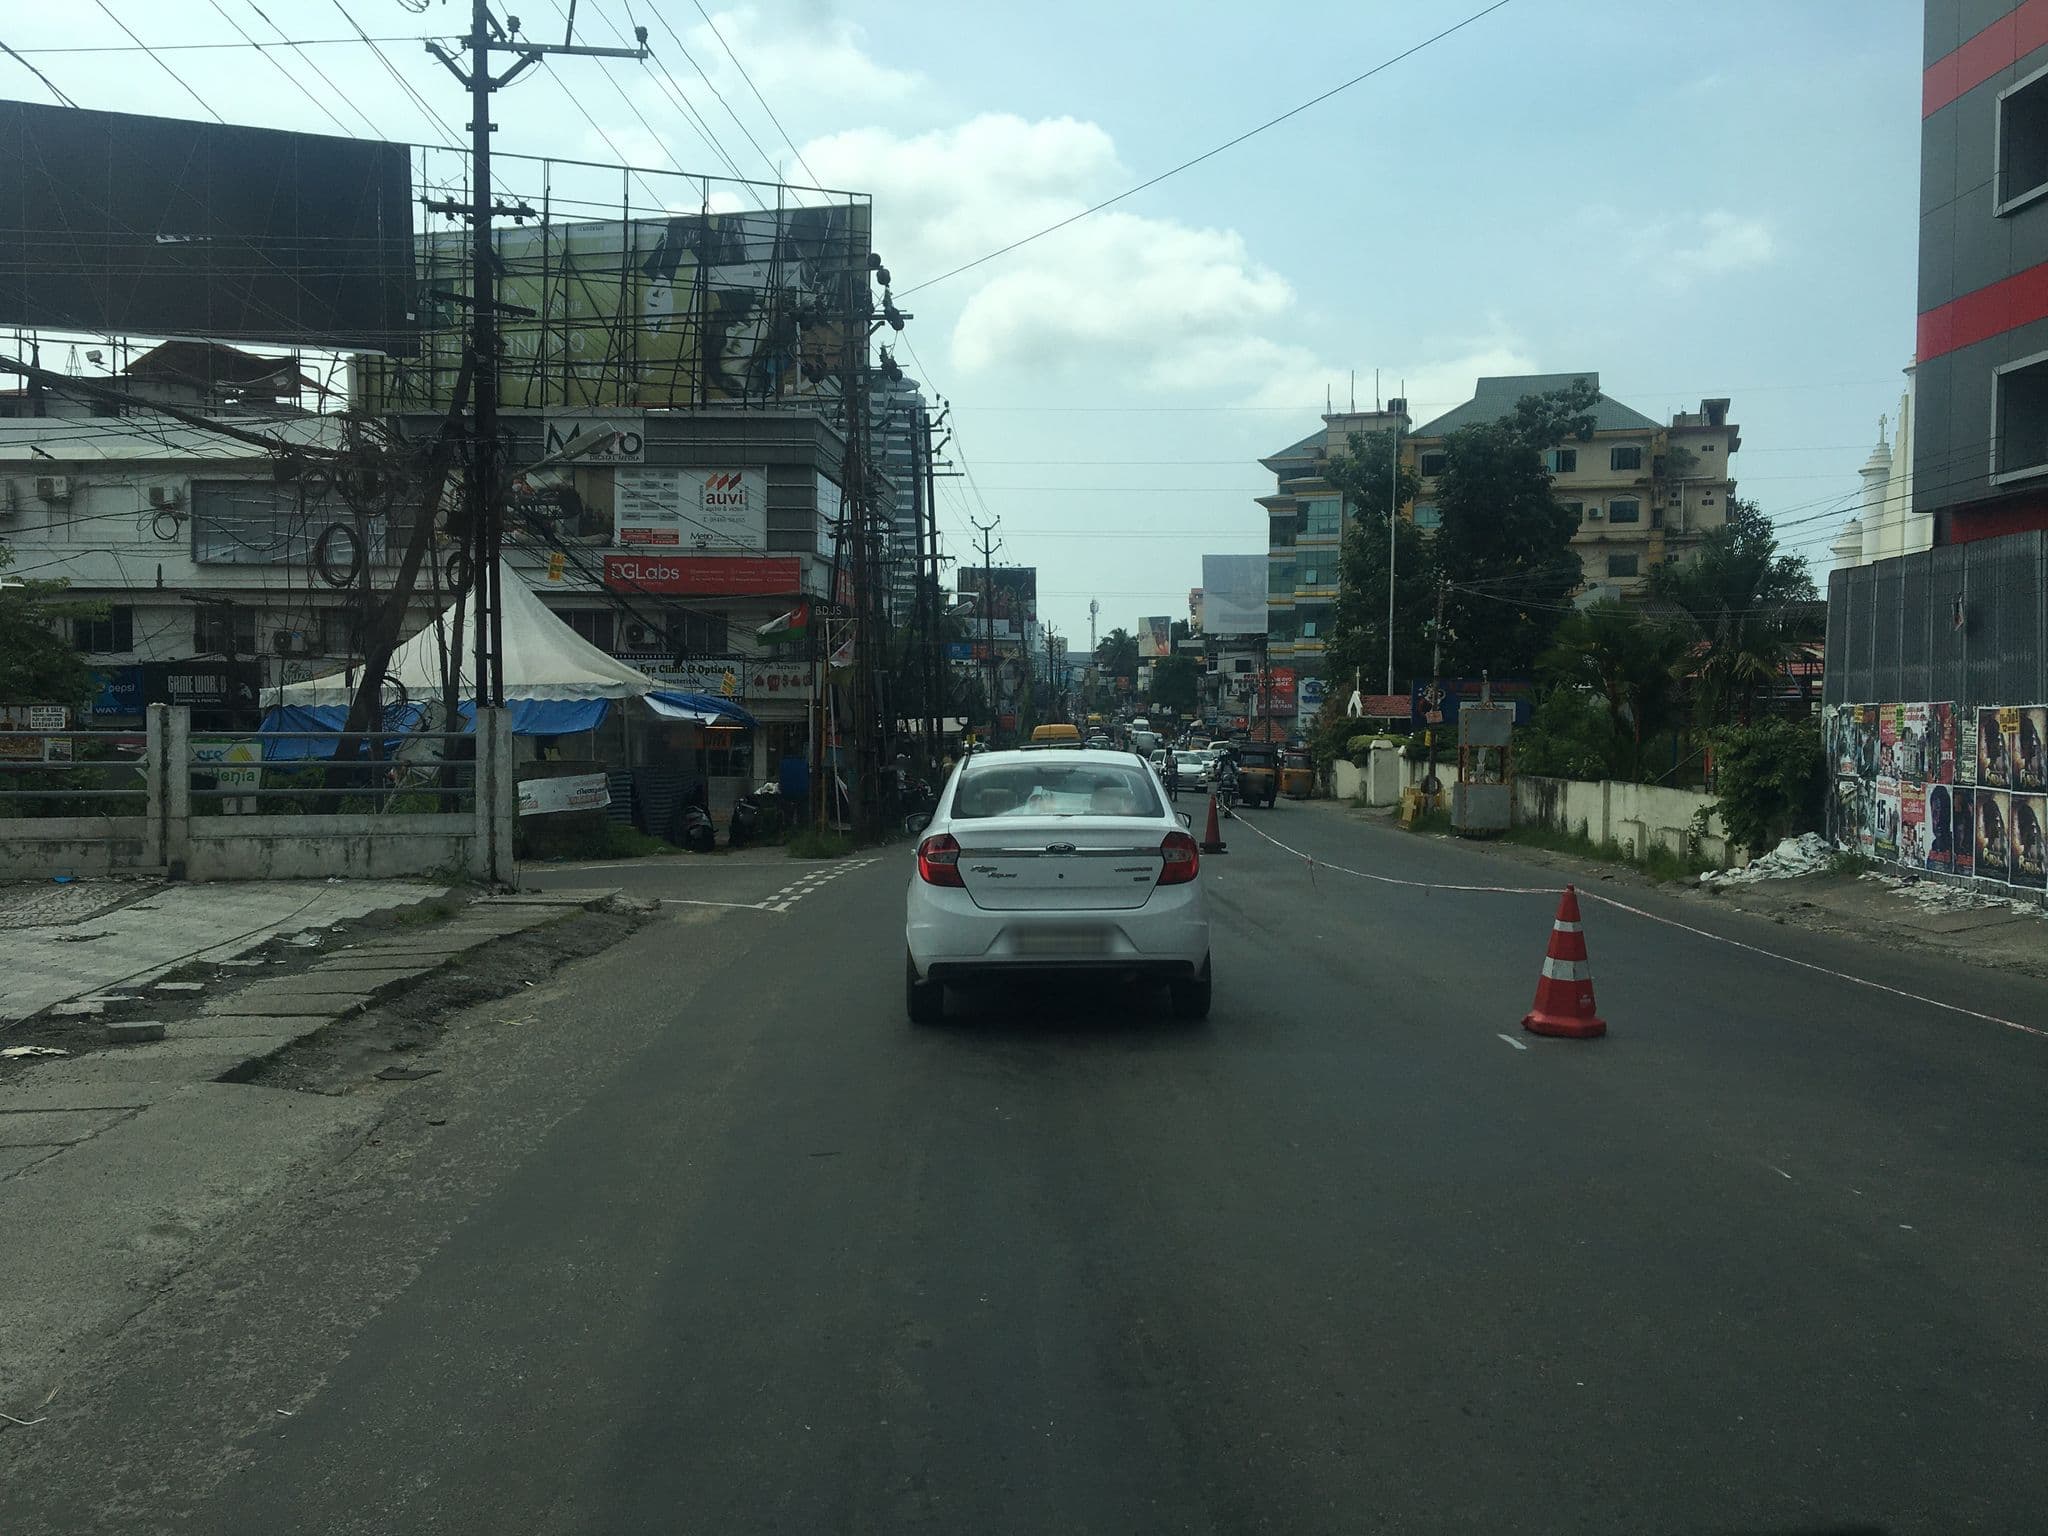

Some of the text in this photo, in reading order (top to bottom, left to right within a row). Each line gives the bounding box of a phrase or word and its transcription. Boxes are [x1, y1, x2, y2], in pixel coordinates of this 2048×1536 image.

[706, 490, 744, 505] auvi
[815, 605, 842, 616] BDJS
[640, 665, 658, 676] Eye
[659, 664, 685, 673] Clinic
[698, 665, 736, 676] Opticals
[108, 683, 135, 694] pepsi
[167, 675, 227, 693] GAME WORD
